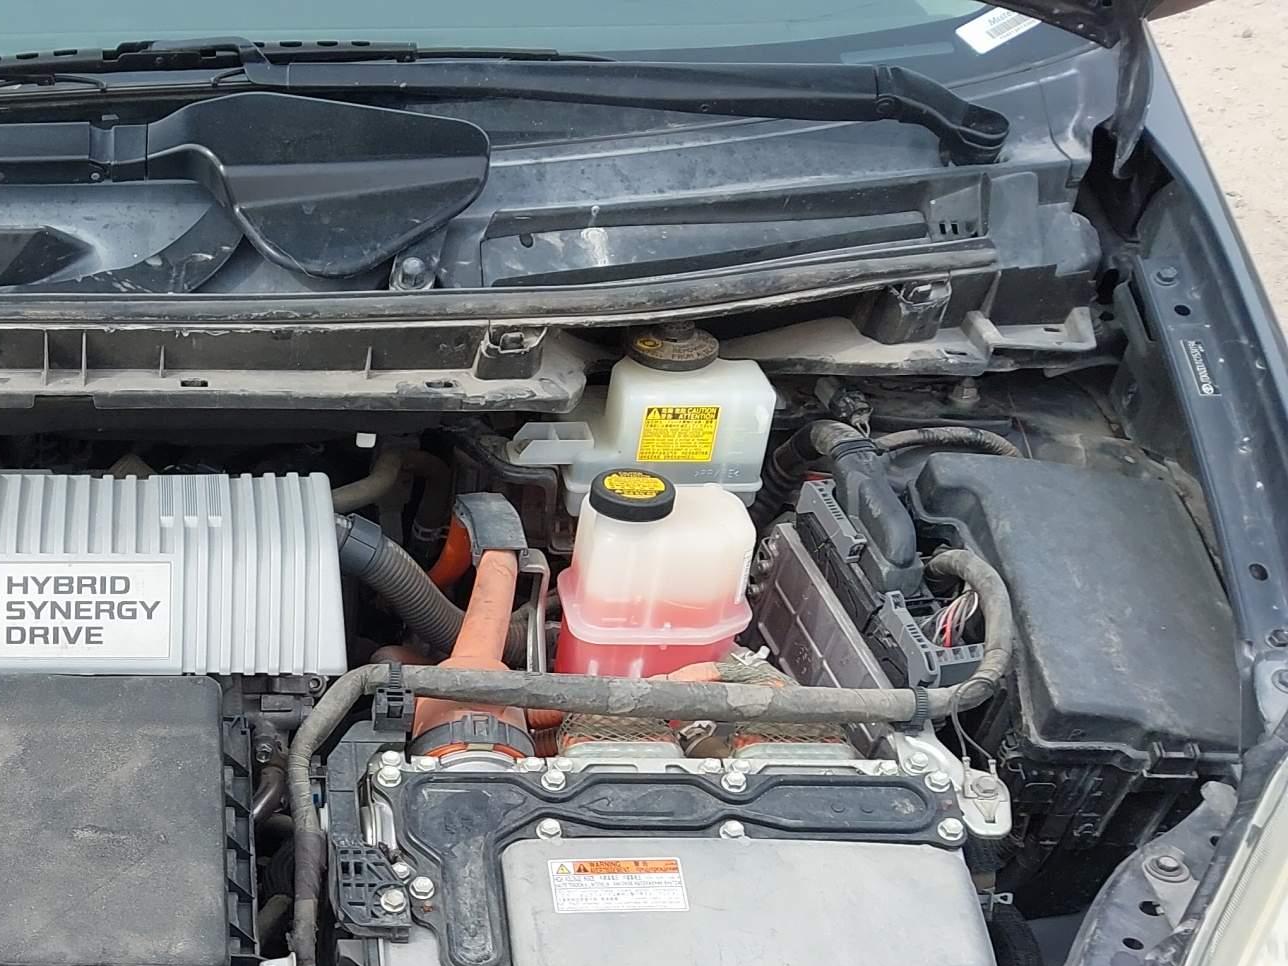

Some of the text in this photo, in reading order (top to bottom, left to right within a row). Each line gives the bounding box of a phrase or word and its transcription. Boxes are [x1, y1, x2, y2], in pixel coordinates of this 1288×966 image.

[6, 575, 131, 595] HYBRID
[5, 600, 161, 620] SYNERGY
[5, 626, 104, 645] DRIVE
